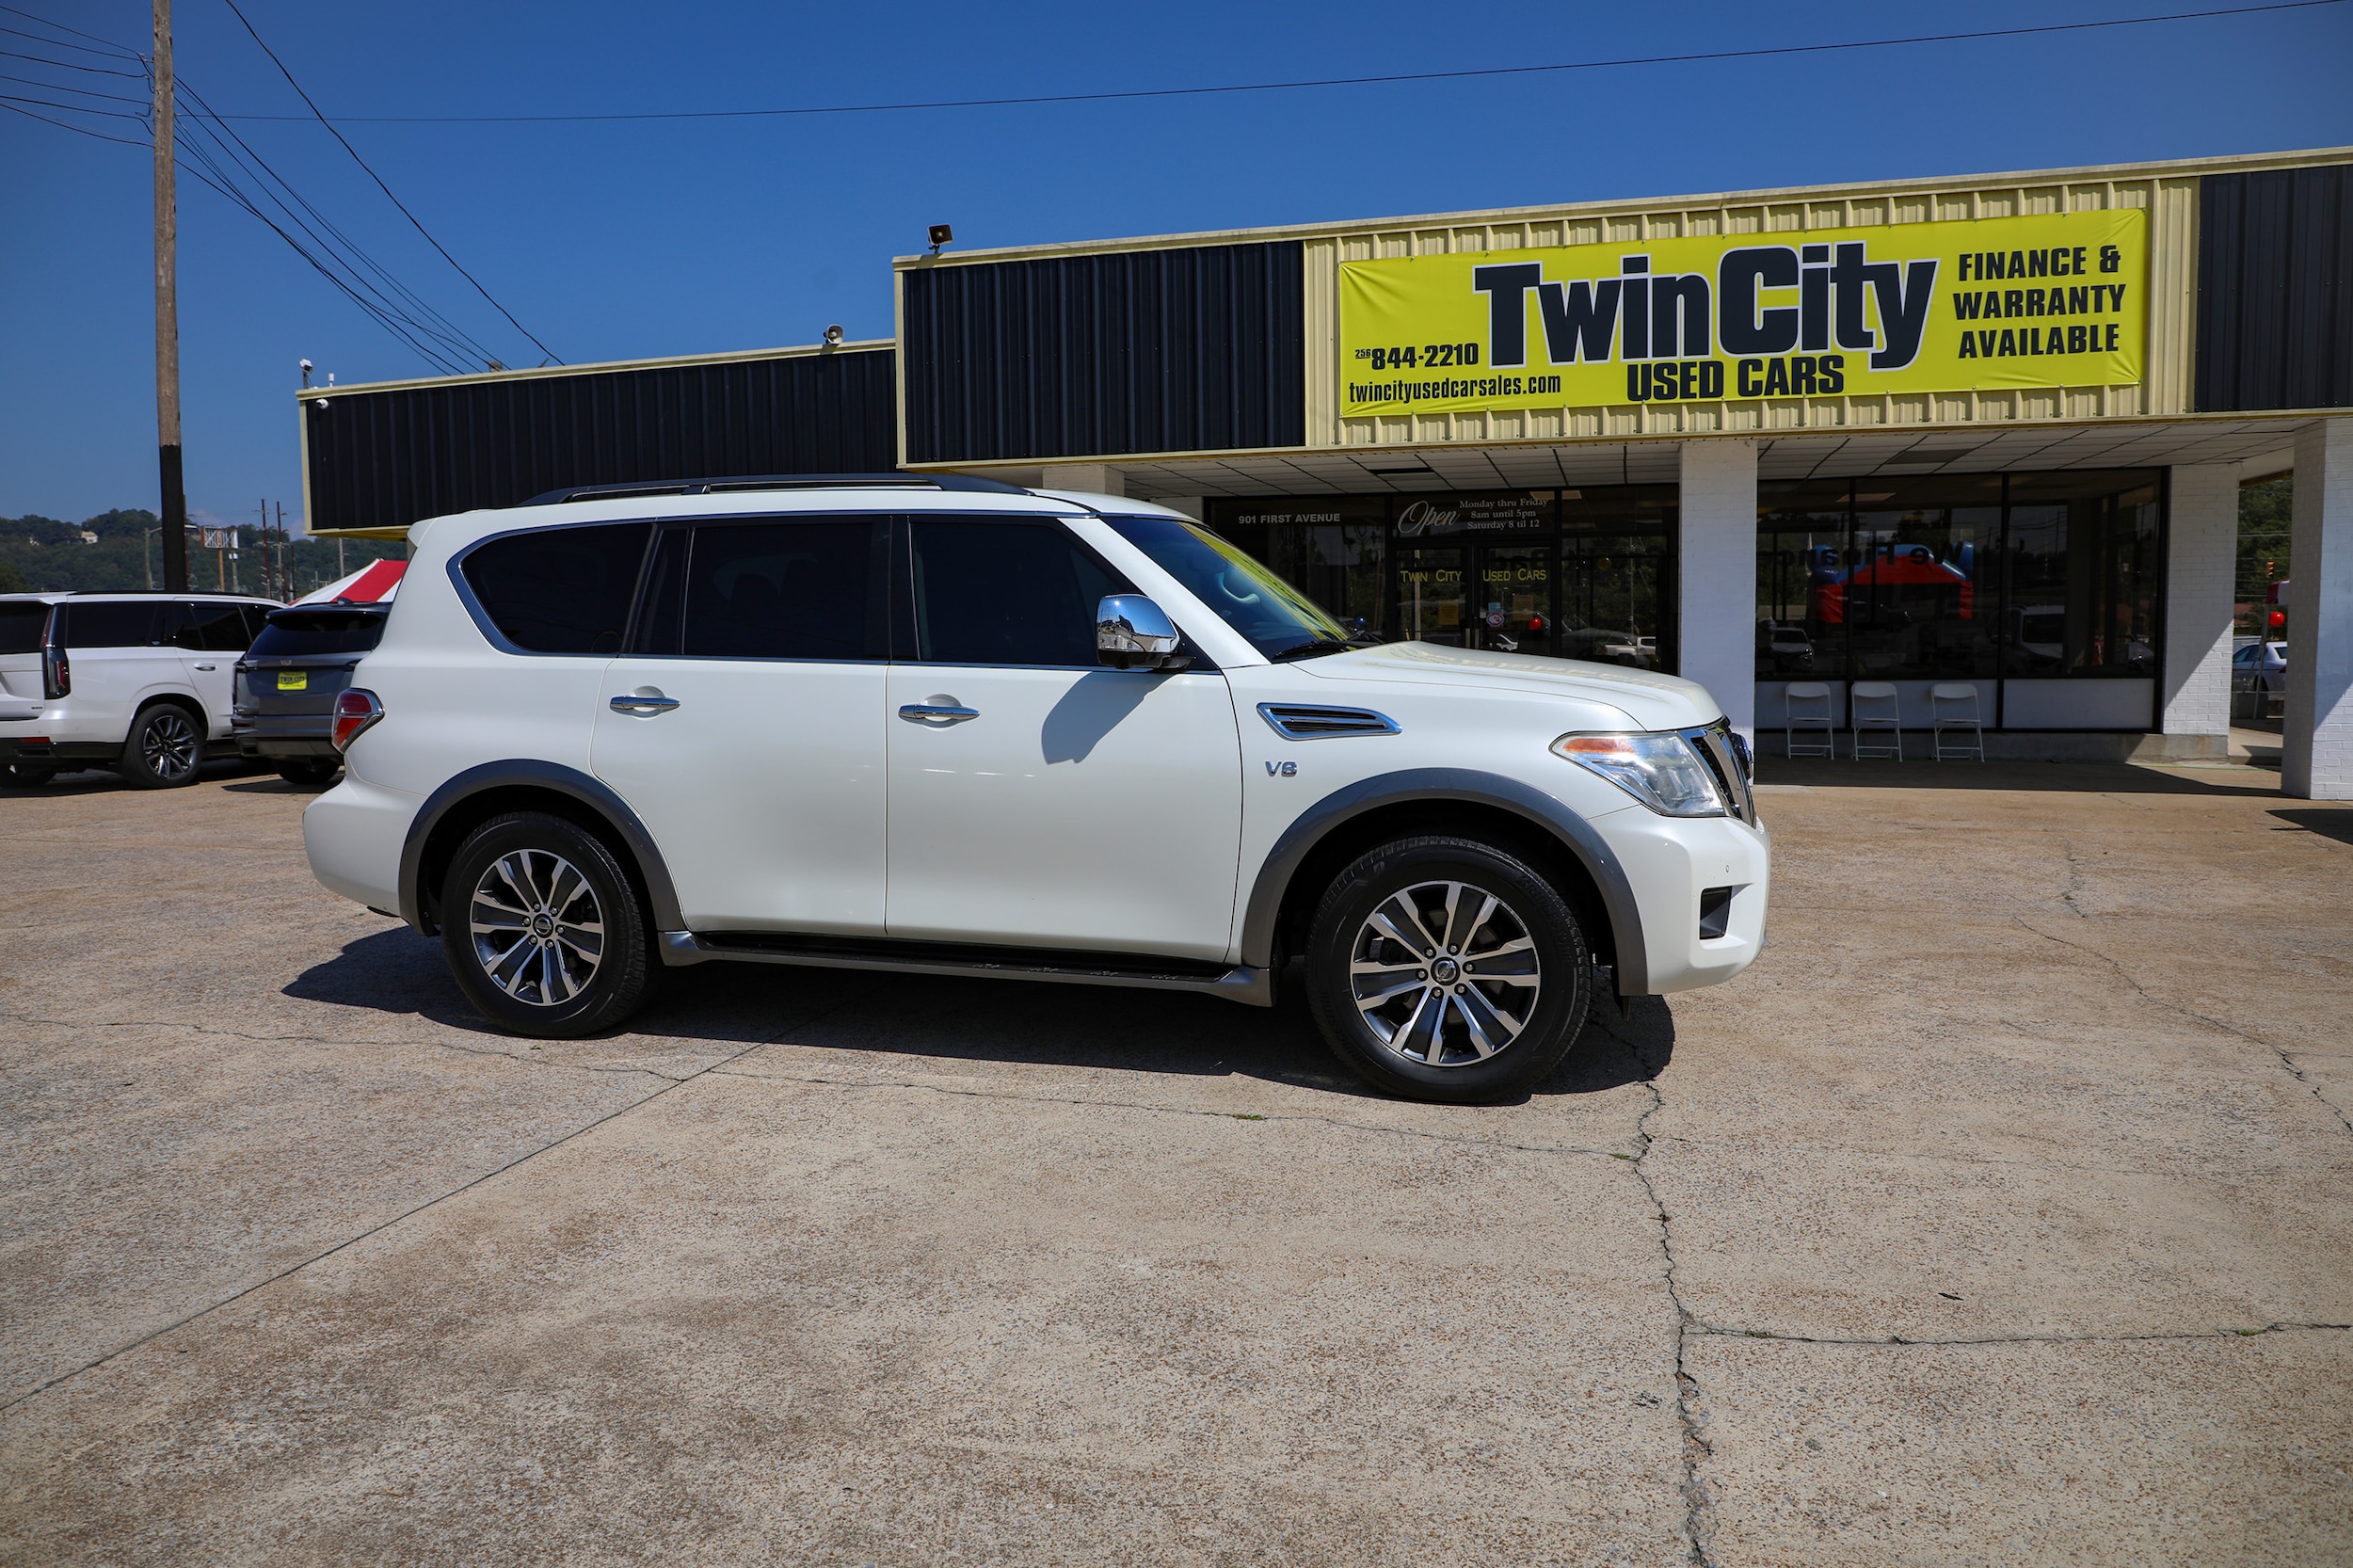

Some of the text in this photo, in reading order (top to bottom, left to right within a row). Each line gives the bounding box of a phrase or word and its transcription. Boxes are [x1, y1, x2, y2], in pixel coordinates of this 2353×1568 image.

[1959, 245, 2121, 281] FINANCE &
[1953, 284, 2126, 320] WARRANTY
[1958, 324, 2120, 359] AVAILABLE
[1350, 375, 1561, 404] twincityusedcarsales.com
[1627, 355, 1845, 402] USED CARS
[1398, 500, 1461, 536] Open
[1459, 498, 1548, 509] Monday thru Friday
[1493, 509, 1513, 518] until
[1516, 509, 1536, 519] 5pm
[1239, 513, 1341, 524] 901 FIRST AVENUE
[1467, 519, 1540, 530] Saturday 8 til 12
[1265, 760, 1298, 777] V8
